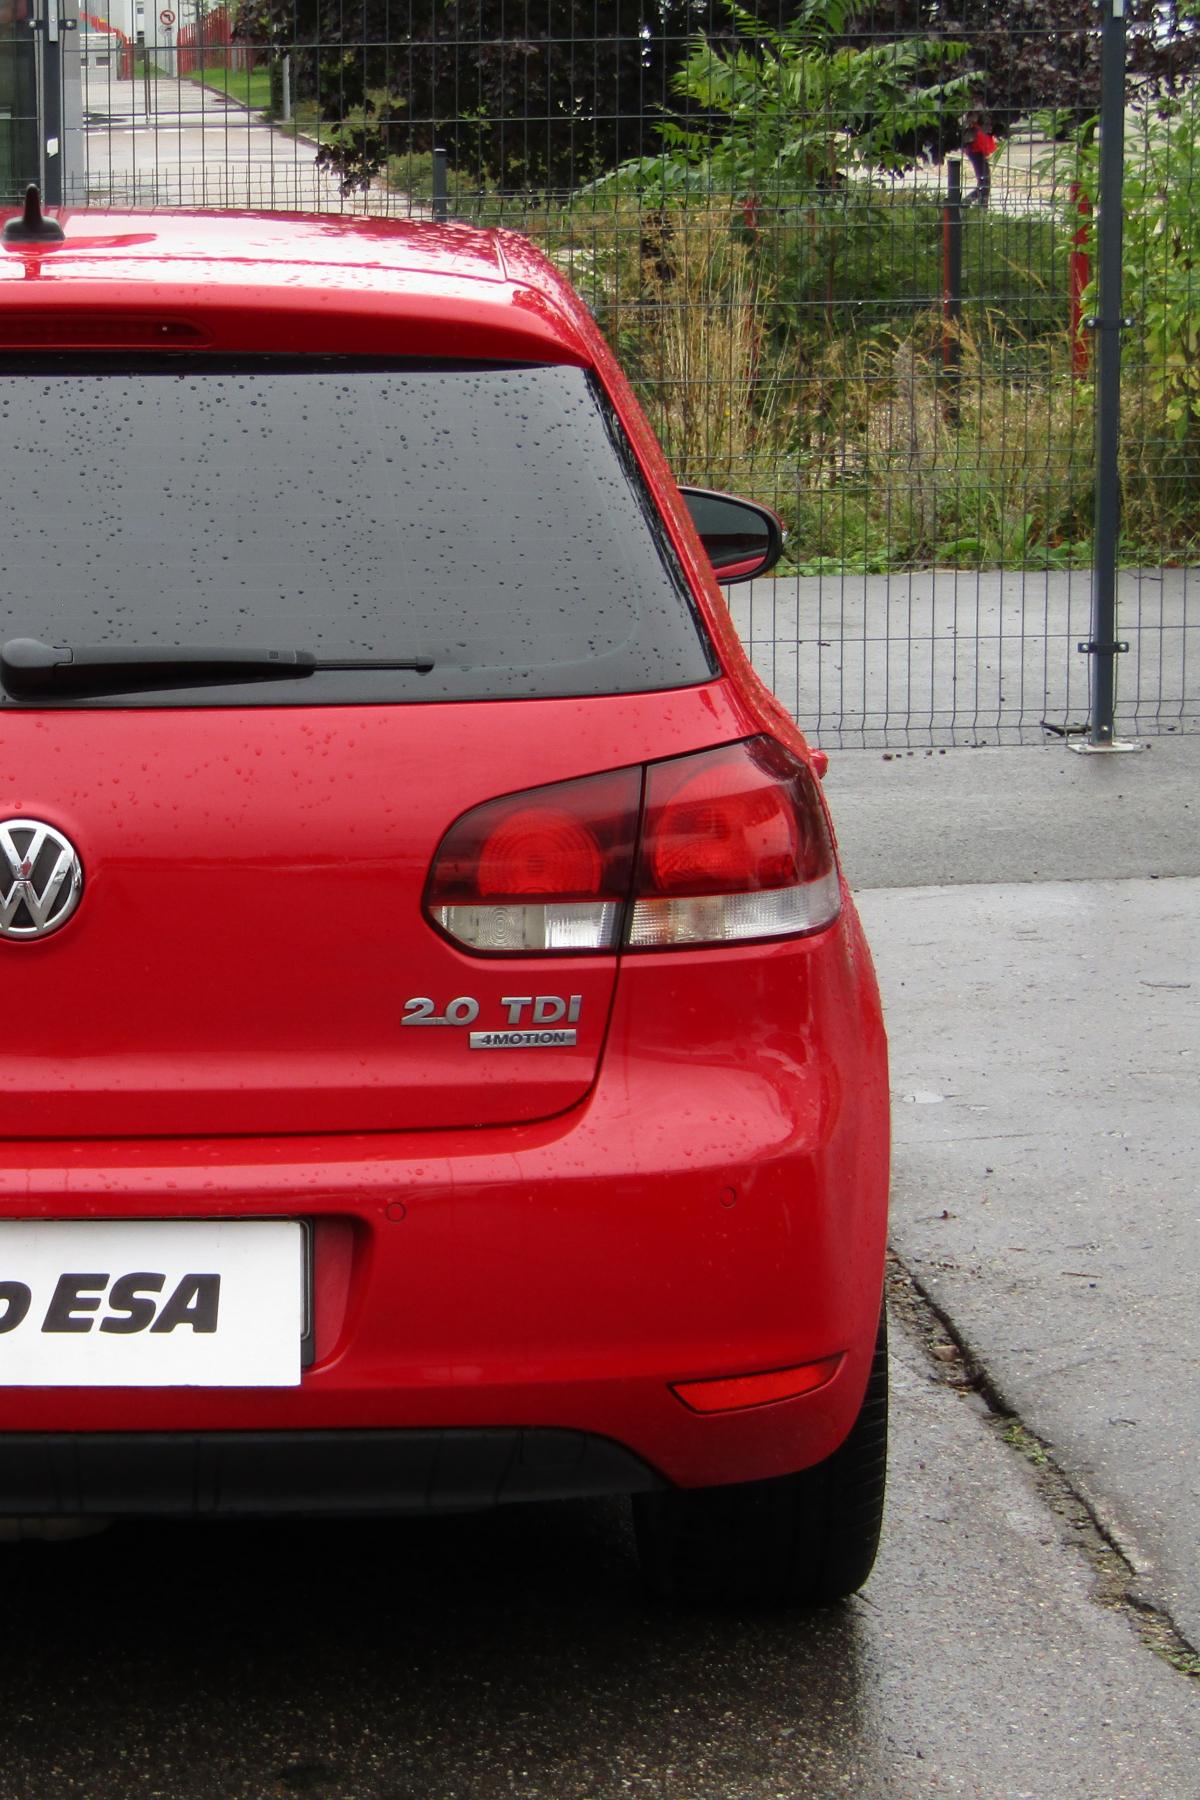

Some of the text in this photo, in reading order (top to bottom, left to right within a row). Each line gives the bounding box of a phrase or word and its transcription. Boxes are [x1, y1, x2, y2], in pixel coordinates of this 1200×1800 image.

[400, 994, 582, 1026] 2.0 TDI
[481, 1032, 566, 1045] 4MOTION
[41, 1273, 221, 1334] ESA
